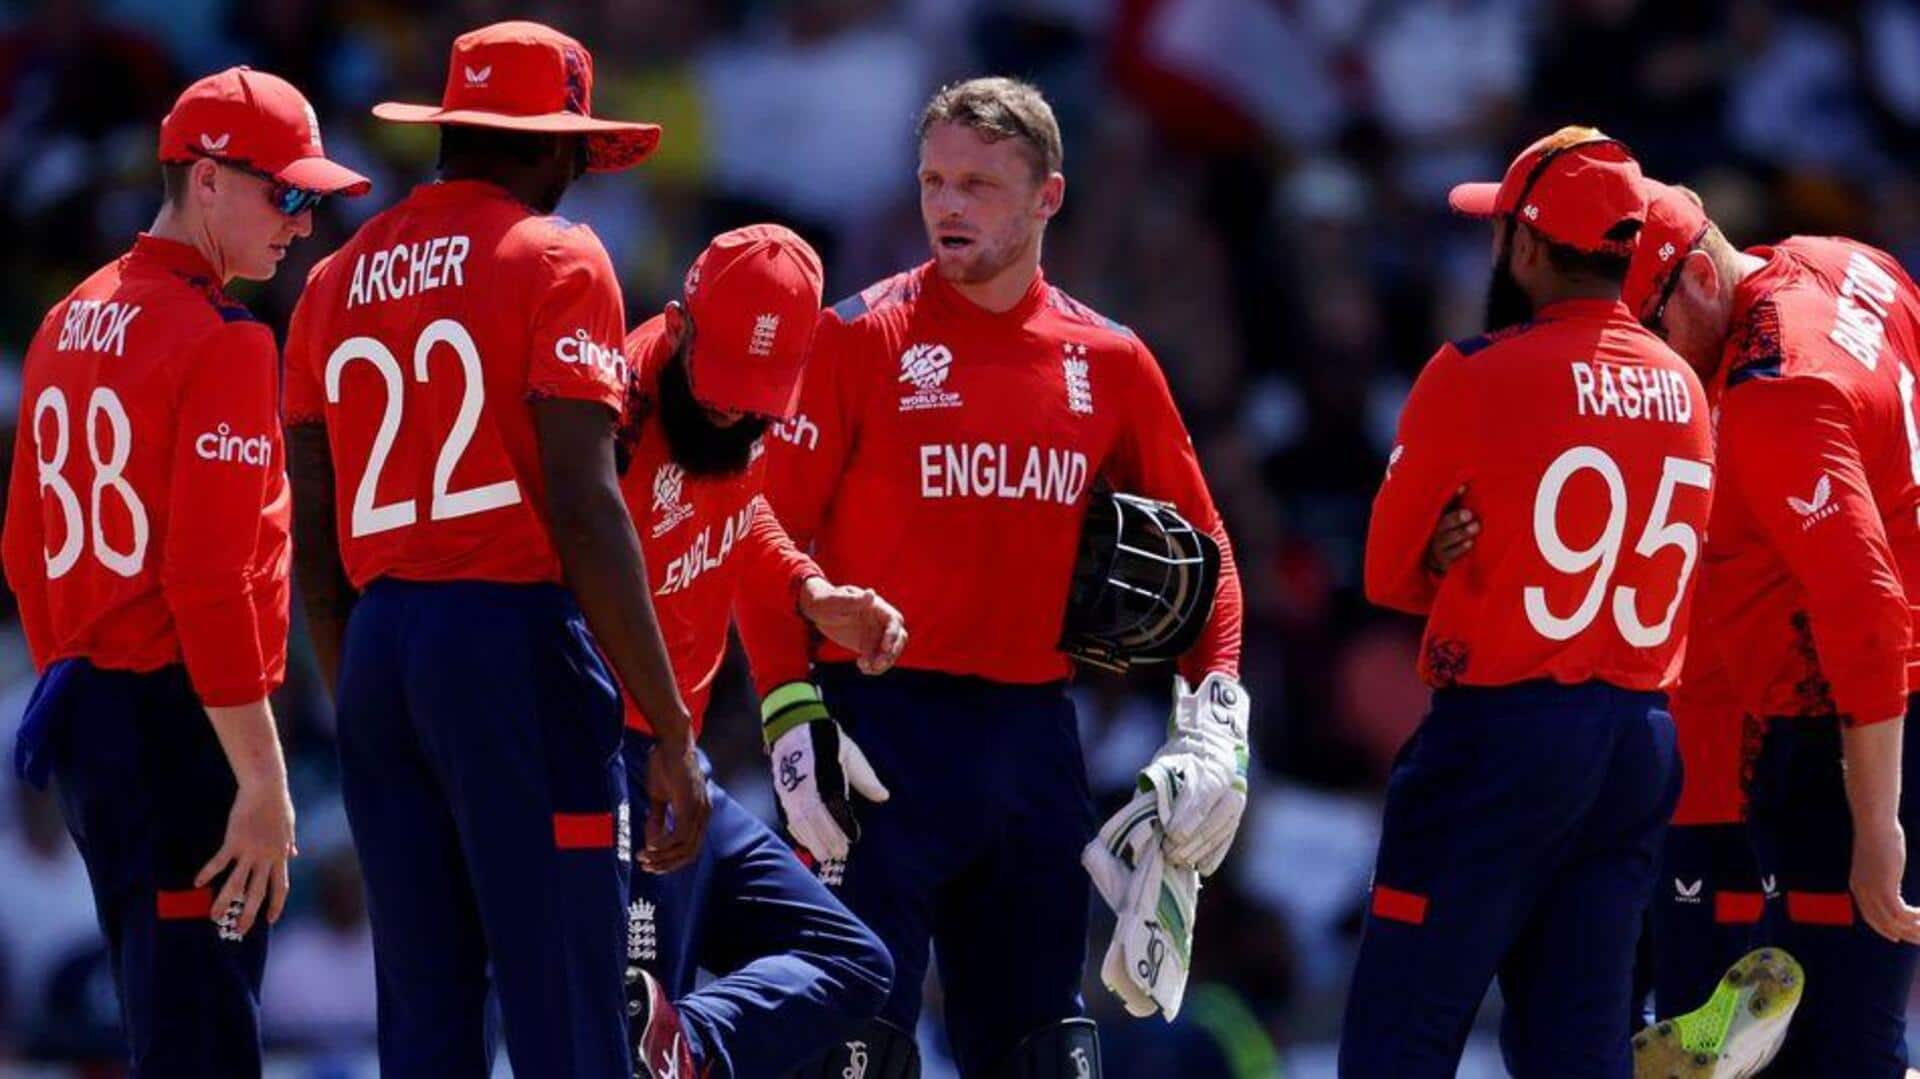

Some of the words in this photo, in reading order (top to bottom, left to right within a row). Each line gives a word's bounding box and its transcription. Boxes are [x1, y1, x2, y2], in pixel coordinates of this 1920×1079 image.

[1523, 204, 1540, 222] 46
[347, 235, 470, 310] ARCHER
[1657, 241, 1676, 262] 56
[57, 300, 142, 357] BROOK
[554, 328, 630, 385] cinch
[1571, 361, 1692, 424] RASHID
[195, 422, 272, 466] cinch
[324, 318, 522, 539] 22
[33, 385, 149, 580] 88
[919, 441, 1088, 506] ENGLAND
[1523, 445, 1714, 649] 95
